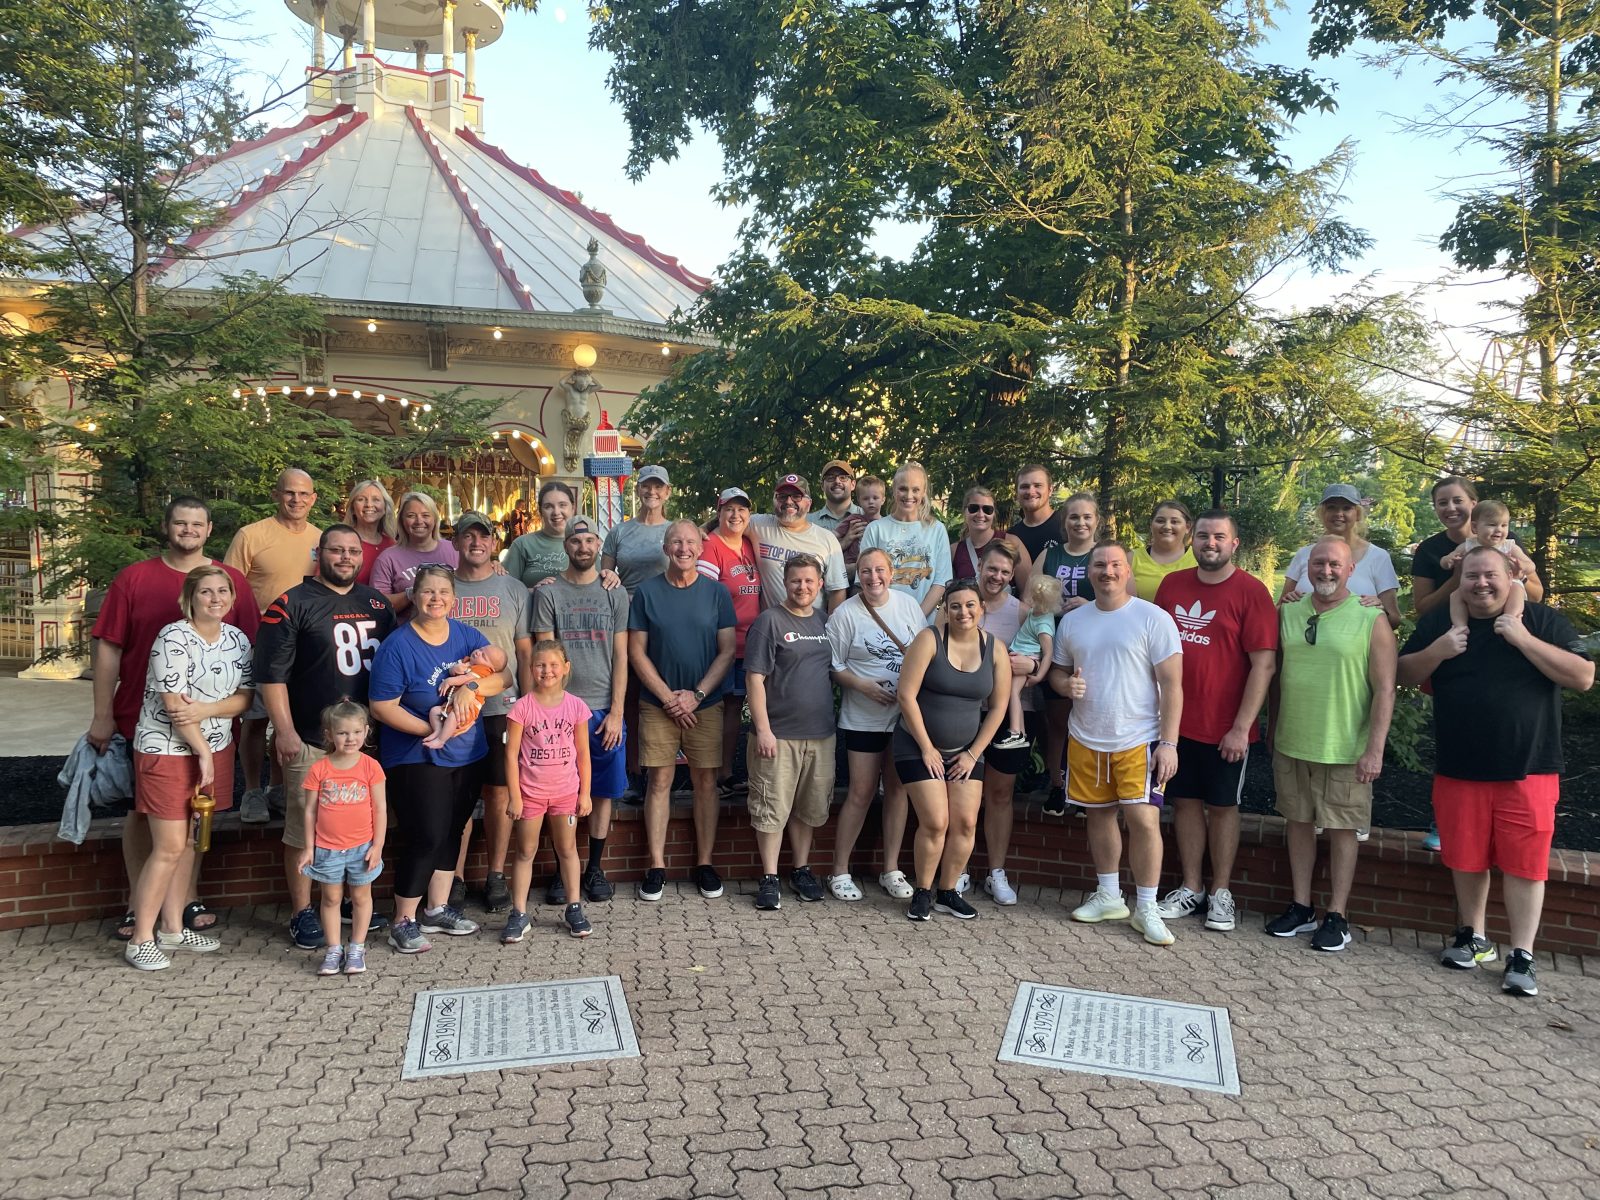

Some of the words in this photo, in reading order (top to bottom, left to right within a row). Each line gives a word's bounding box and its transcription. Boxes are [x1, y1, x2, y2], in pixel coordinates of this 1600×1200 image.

[768, 546, 785, 559] TOP
[1056, 565, 1086, 579] BE
[739, 585, 760, 595] RED
[1061, 579, 1078, 596] KI
[448, 595, 500, 619] REDS
[576, 612, 614, 632] JACKETS
[568, 640, 600, 649] HOCKEY
[784, 632, 829, 643] Champi
[1178, 629, 1211, 646] didas
[333, 620, 381, 677] 85
[525, 731, 533, 740] I
[532, 719, 549, 736] AM
[554, 718, 575, 738] WITH
[544, 733, 561, 745] MY
[530, 746, 571, 760] BESTIES
[436, 1016, 456, 1039] 1980
[1033, 1010, 1054, 1032] 1979
